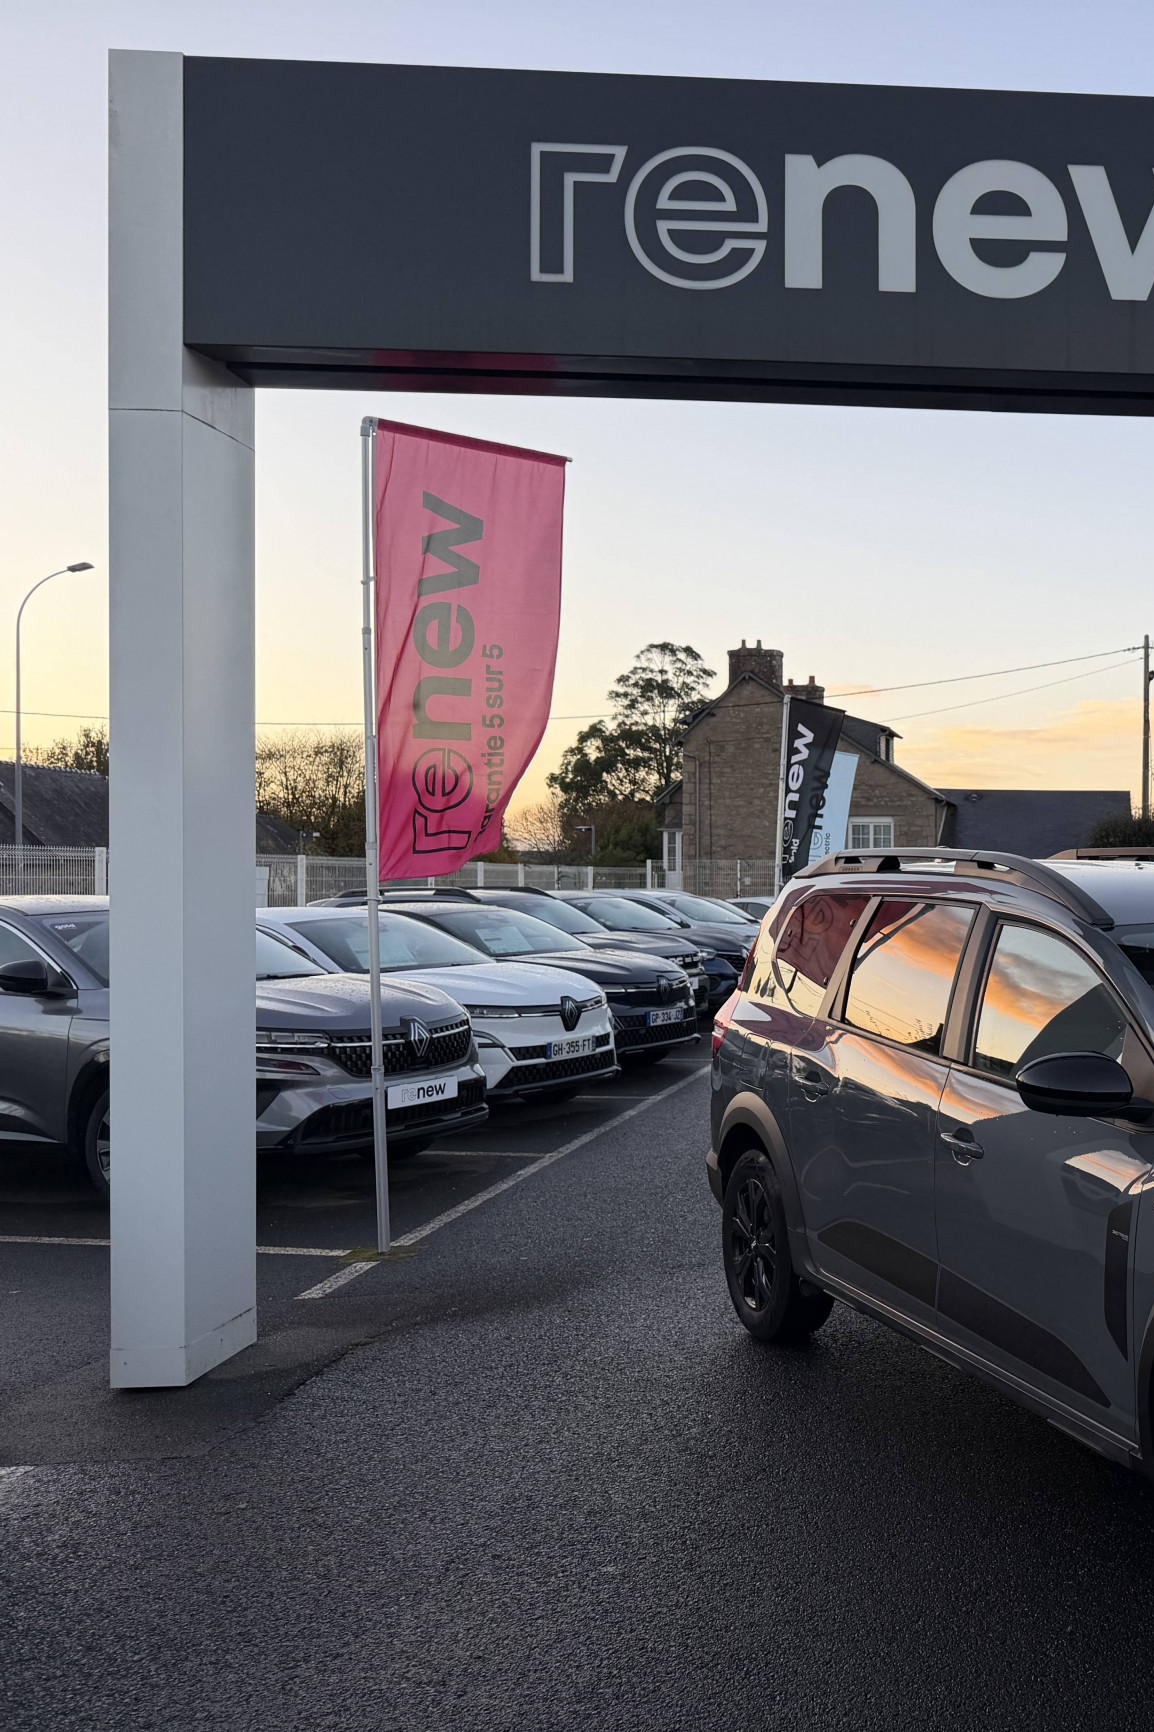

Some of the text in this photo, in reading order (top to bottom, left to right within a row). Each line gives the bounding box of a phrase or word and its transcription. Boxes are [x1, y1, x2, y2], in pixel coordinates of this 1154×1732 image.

[482, 643, 504, 660] 5
[411, 490, 484, 855] renew
[486, 664, 504, 709] sur
[482, 714, 505, 730] 5
[553, 1038, 591, 1056] GH-355-FT
[401, 1083, 446, 1103] renew
